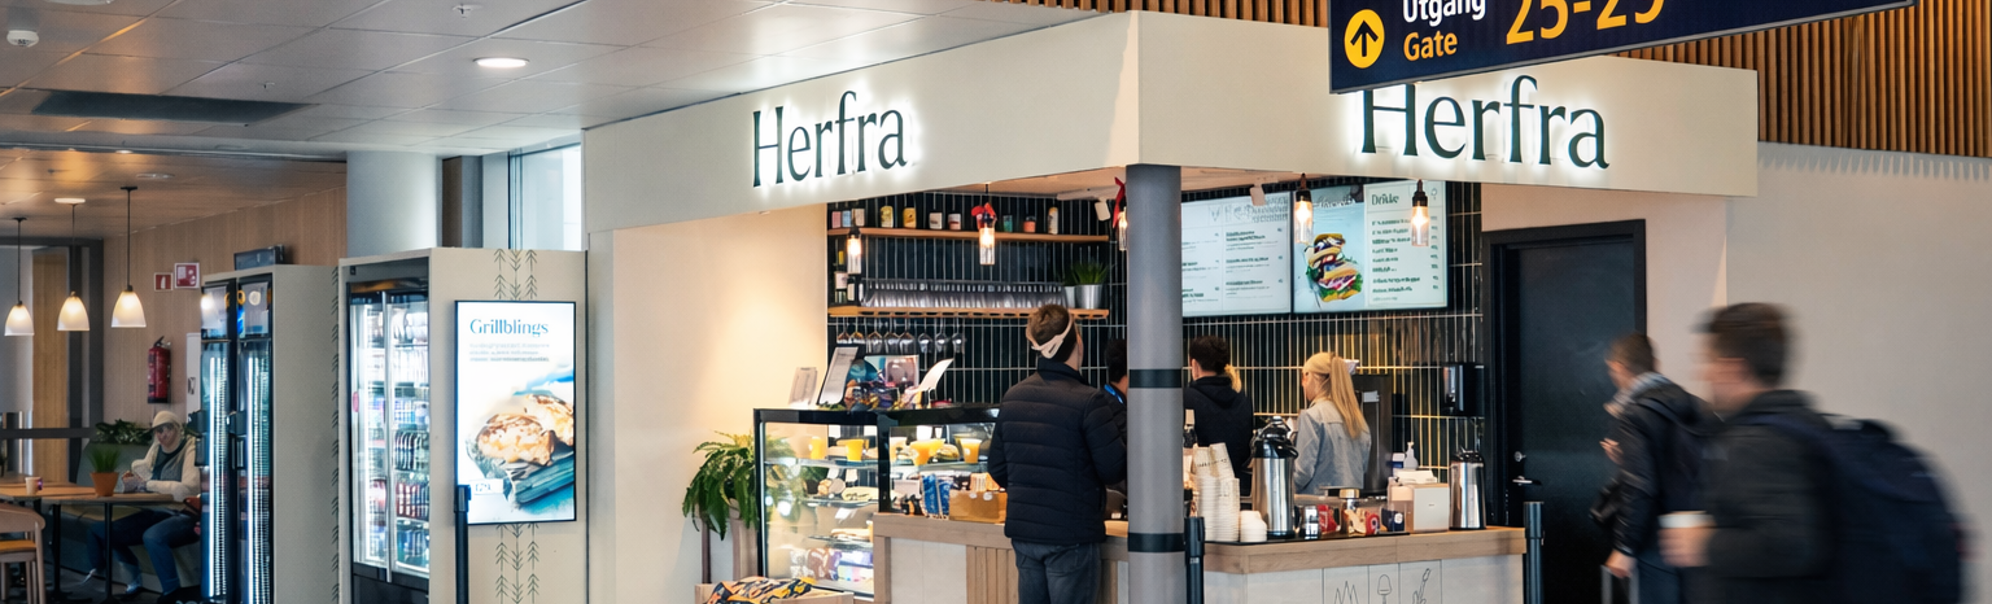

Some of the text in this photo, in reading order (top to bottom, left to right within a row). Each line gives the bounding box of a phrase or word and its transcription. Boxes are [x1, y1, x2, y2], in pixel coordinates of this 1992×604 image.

[1403, 30, 1458, 62] Gate
[753, 90, 907, 187] Herfra
[1361, 75, 1610, 169] Herfra
[469, 319, 549, 337] Grillblings
